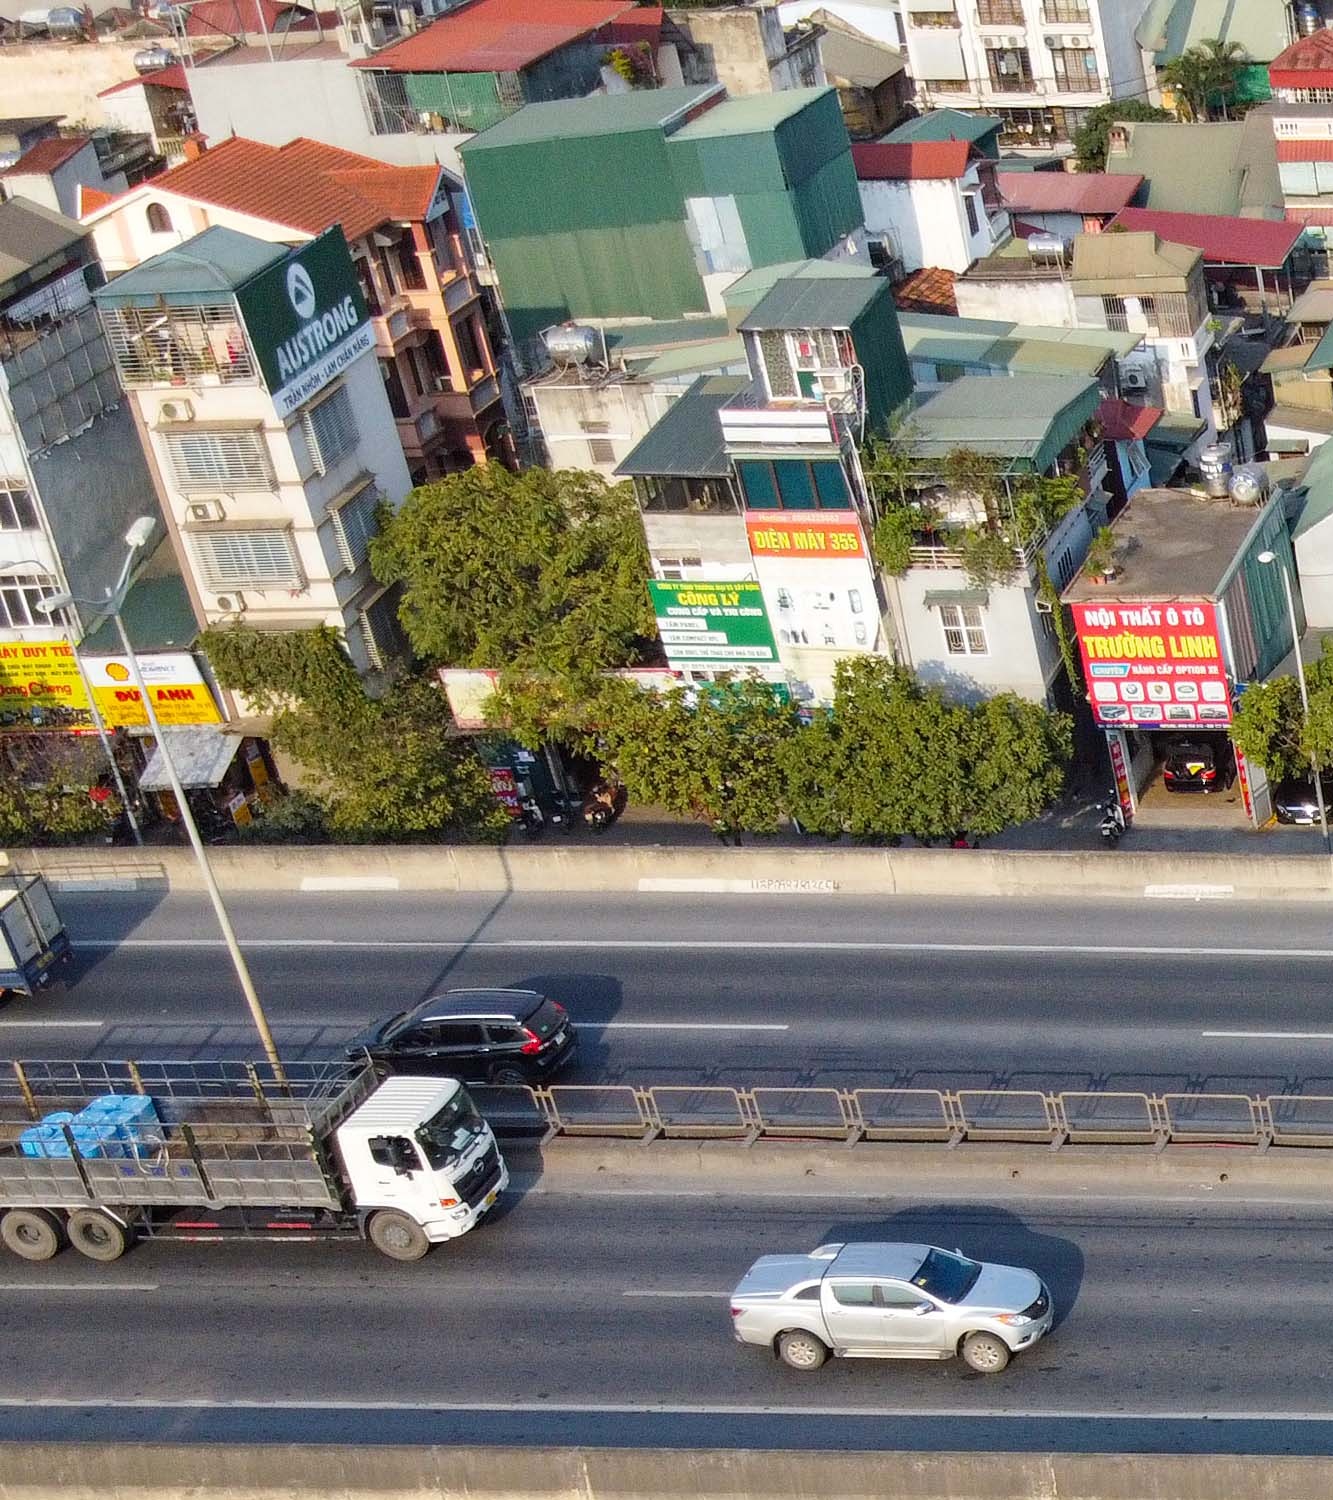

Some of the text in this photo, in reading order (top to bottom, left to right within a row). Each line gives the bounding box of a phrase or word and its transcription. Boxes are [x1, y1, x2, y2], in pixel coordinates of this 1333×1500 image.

[276, 295, 358, 382] AUSTRONG
[753, 527, 859, 552] ĐIỆN MÁY 355
[677, 590, 720, 607] CÔNG
[1083, 604, 1205, 630] NỘI THẤT Ô TÔ
[23, 646, 48, 658] DUY
[1082, 630, 1218, 658] TRƯỜNG LINH
[156, 688, 195, 701] ANH
